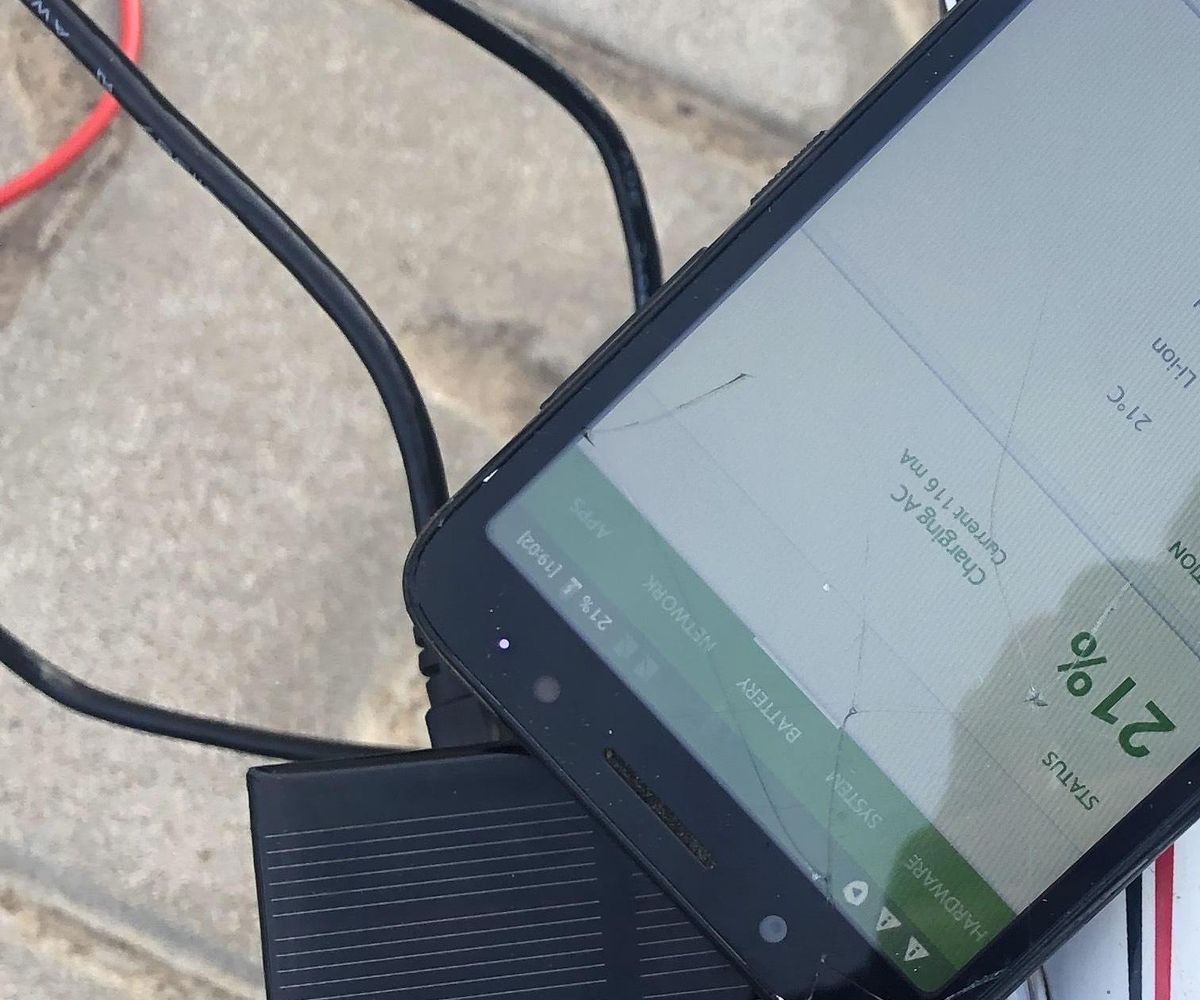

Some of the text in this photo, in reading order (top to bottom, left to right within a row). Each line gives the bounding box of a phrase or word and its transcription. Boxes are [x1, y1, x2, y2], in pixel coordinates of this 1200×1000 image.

[1150, 336, 1197, 389] Li-ion
[1105, 384, 1153, 432] 21°C
[572, 497, 612, 539] APPS
[889, 483, 986, 586] Charging AC
[898, 447, 1007, 566] Current 116 mA
[515, 529, 613, 631] 21% [19:02]
[641, 574, 717, 649] NETWORK
[735, 677, 802, 743] BATTERY
[1056, 630, 1177, 758] 21%
[824, 769, 883, 829] SYSTEM
[1041, 750, 1100, 811] STATUS
[901, 852, 987, 941] HARDWARE
